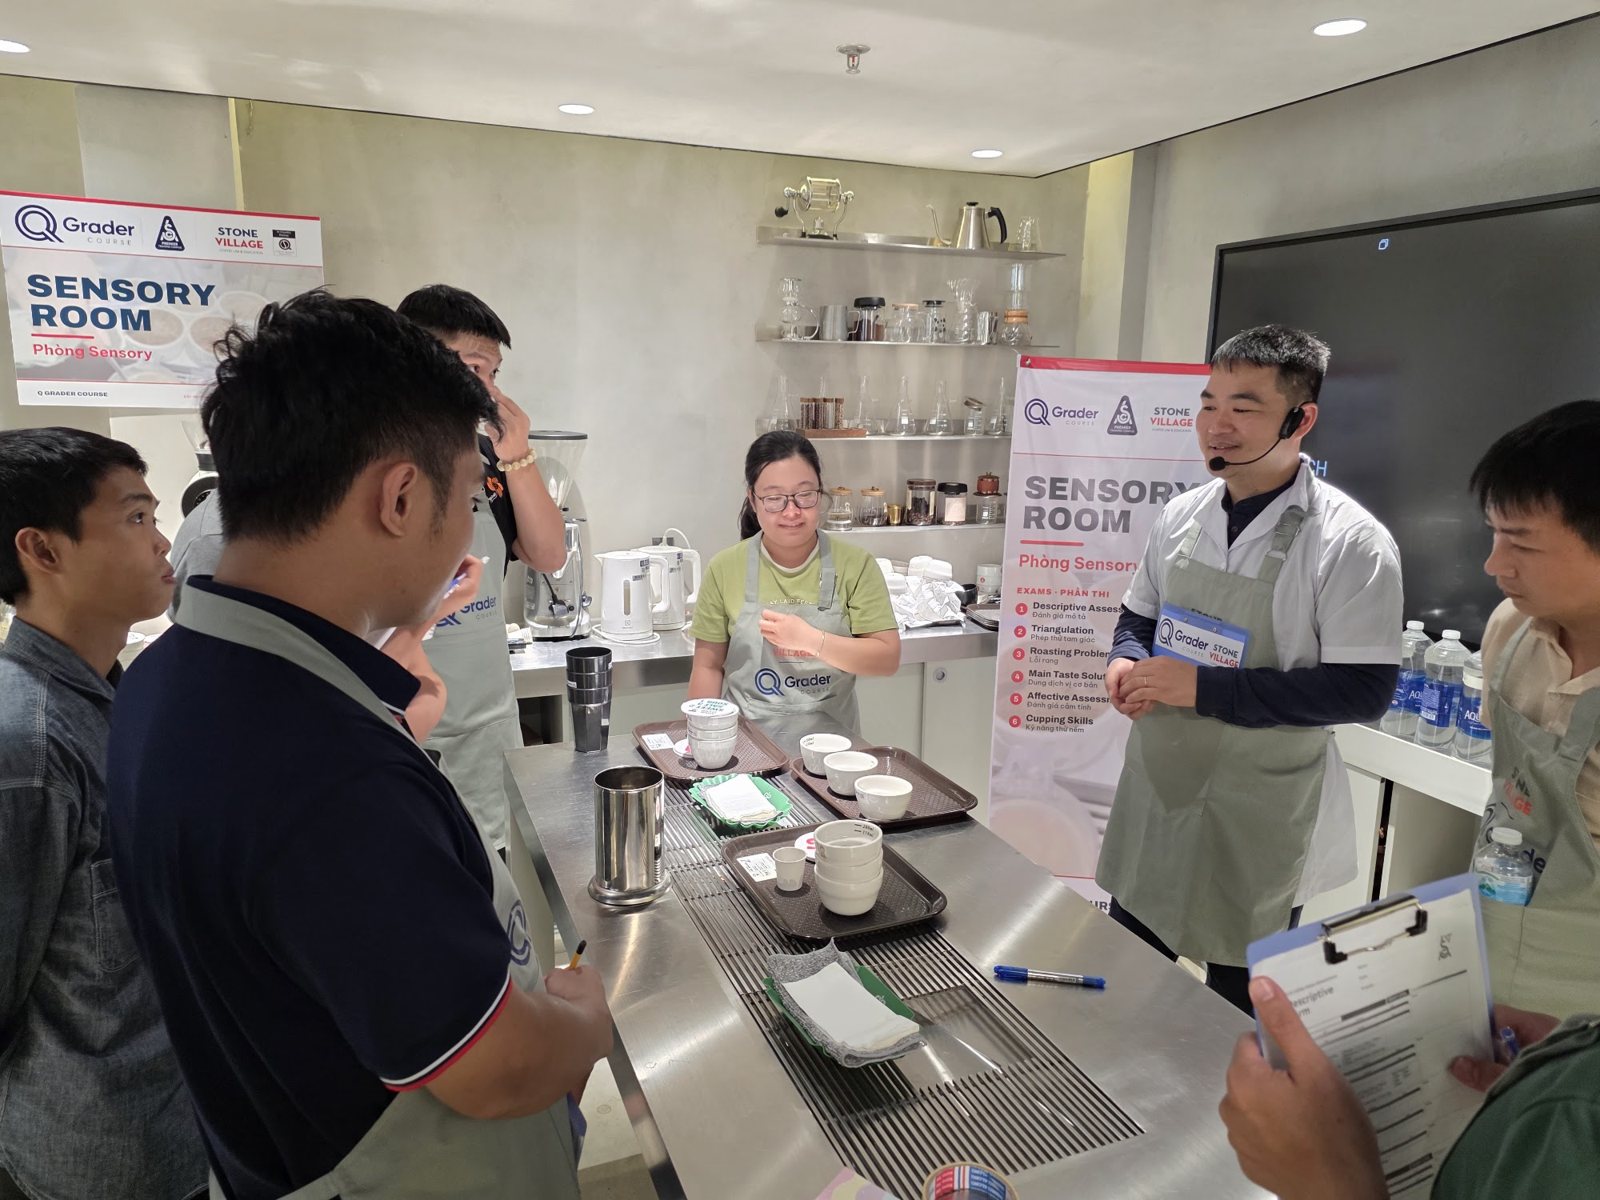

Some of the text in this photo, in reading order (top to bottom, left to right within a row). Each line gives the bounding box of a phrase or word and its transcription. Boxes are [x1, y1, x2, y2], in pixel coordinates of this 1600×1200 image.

[63, 217, 135, 236] Grader
[218, 227, 258, 238] STONE
[87, 237, 132, 246] COURSE
[215, 238, 263, 249] VILLAGE
[27, 274, 215, 306] SENSORY
[31, 304, 151, 332] ROOM
[33, 343, 152, 361] Phòng Sensory
[1052, 406, 1099, 419] Grader
[1154, 407, 1190, 416] STONE
[1150, 417, 1193, 427] VILLAGE
[1024, 476, 1200, 505] SENSORY
[1023, 506, 1131, 533] ROOM
[1019, 554, 1070, 573] Phòng
[1092, 590, 1110, 598] THI
[1033, 602, 1086, 612] Descriptive
[1031, 625, 1094, 635] Triangulation
[1175, 630, 1209, 651] Grader
[1030, 647, 1072, 657] Roasting
[1213, 644, 1239, 659] STONE
[1209, 652, 1239, 668] VILLAGE
[785, 674, 831, 688] Grader
[1028, 670, 1051, 678] Main
[1053, 671, 1079, 679] Taste
[1027, 692, 1070, 701] Affective
[1026, 715, 1065, 725] Cupping
[1067, 716, 1093, 725] Skills
[1293, 986, 1335, 1007] escriptive
